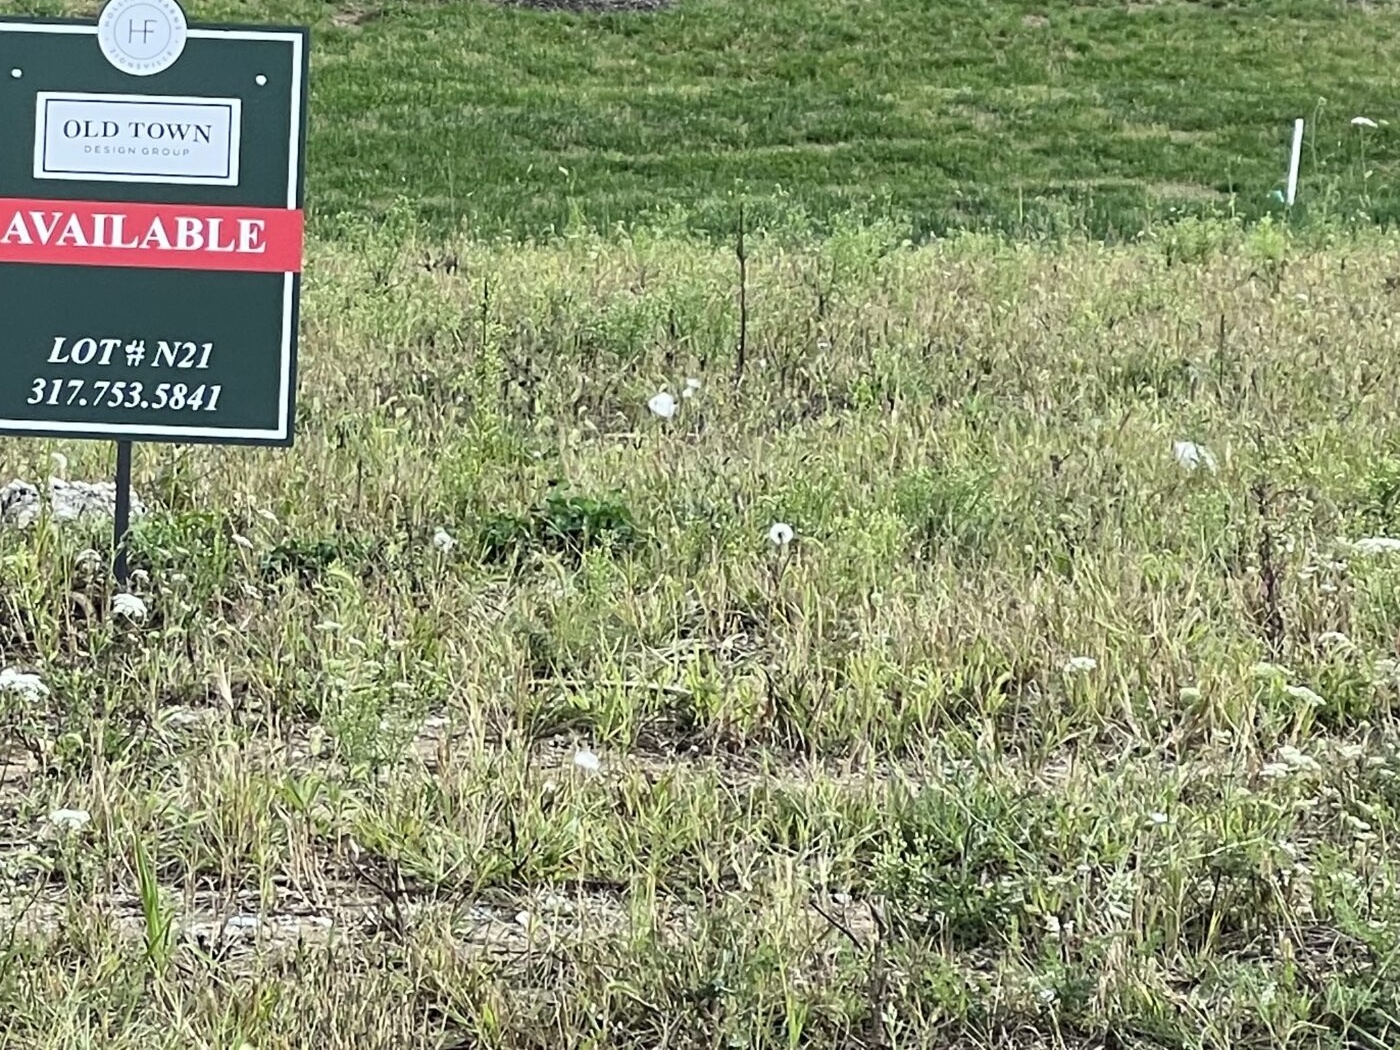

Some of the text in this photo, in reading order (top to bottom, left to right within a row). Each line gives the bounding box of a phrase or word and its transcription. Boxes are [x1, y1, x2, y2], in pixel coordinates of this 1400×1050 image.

[128, 19, 157, 44] HF
[63, 119, 212, 143] OLD TOWN
[84, 145, 190, 157] DESIGN GROUP
[0, 210, 266, 253] AVAILABLE
[151, 340, 213, 369] N21
[27, 377, 222, 411] 317.753.5841
